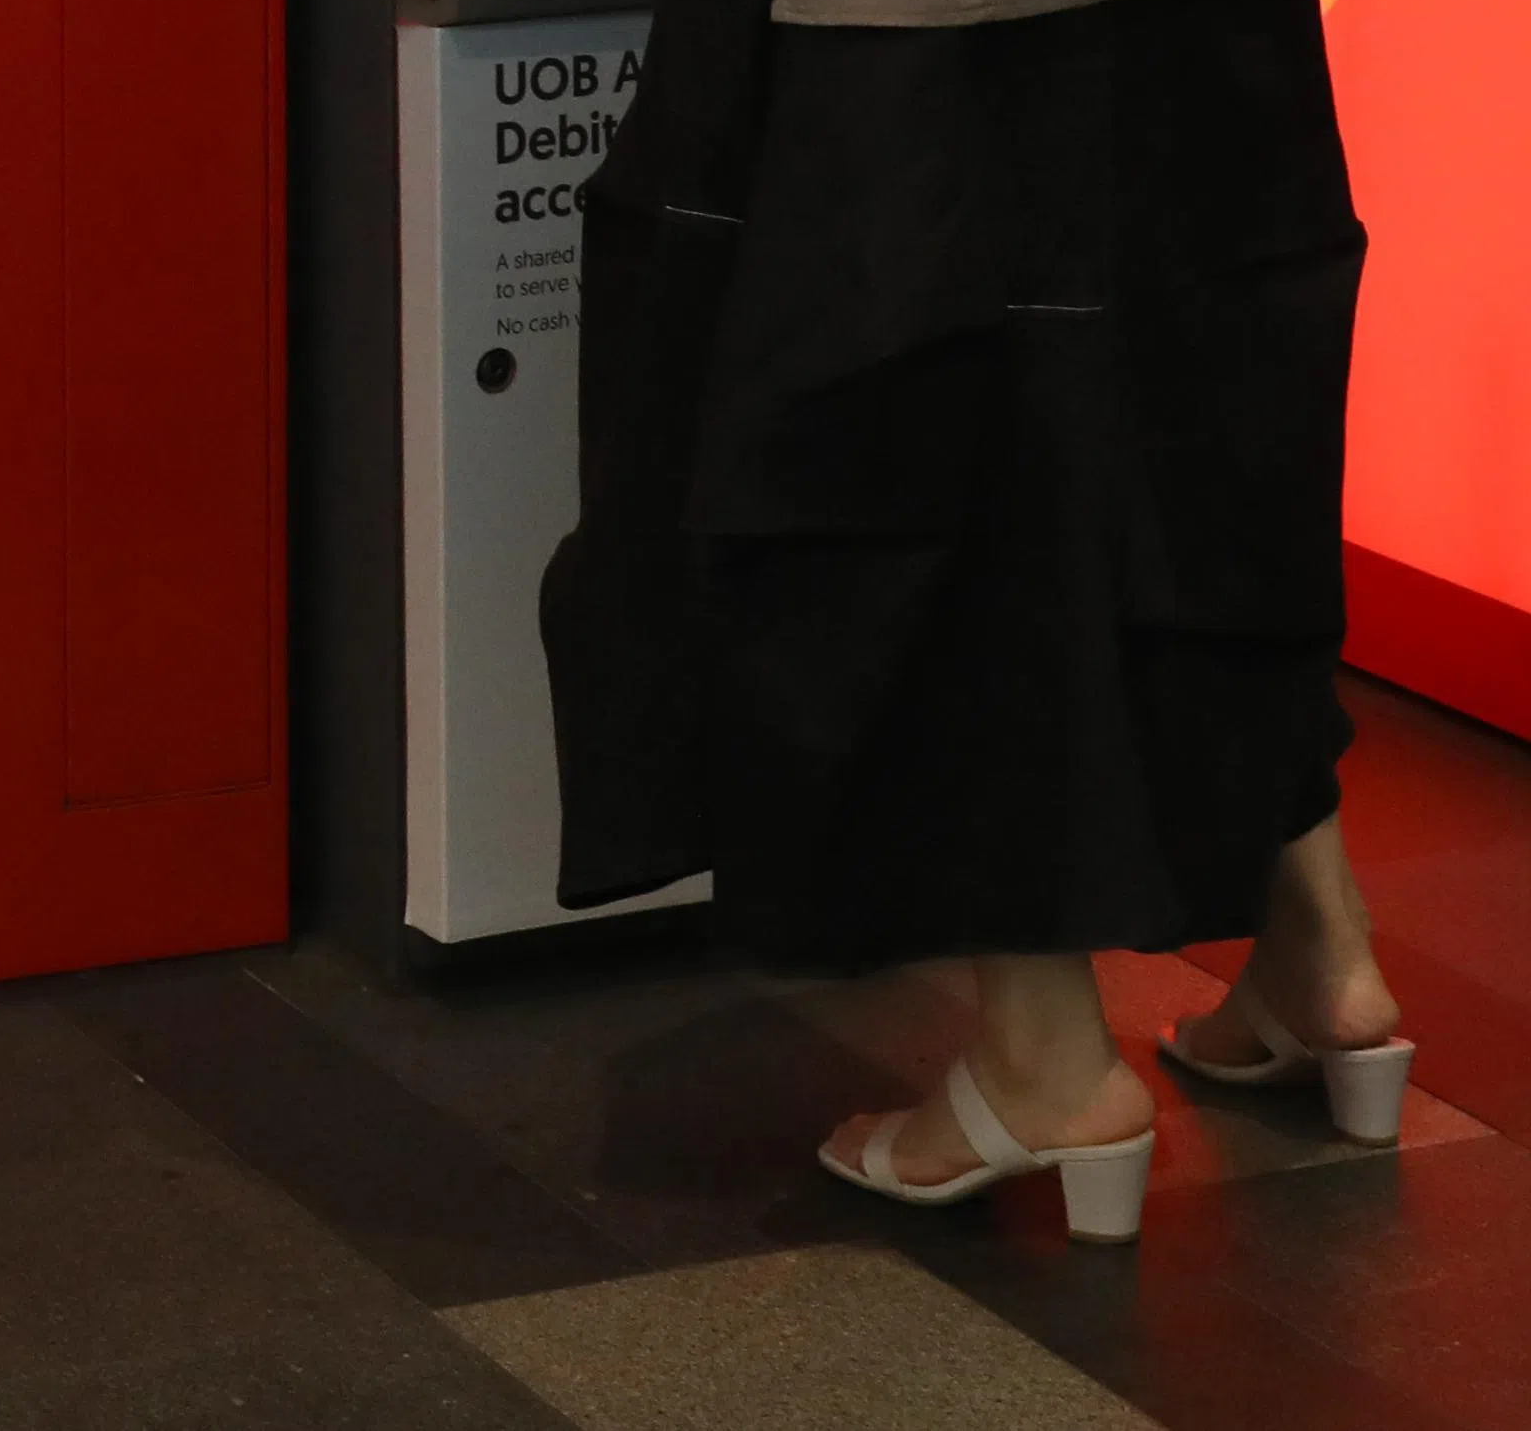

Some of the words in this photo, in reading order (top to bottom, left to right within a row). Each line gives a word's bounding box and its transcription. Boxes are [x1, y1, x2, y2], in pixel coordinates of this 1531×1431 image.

[494, 54, 599, 105] UOB
[495, 110, 618, 165] Debit
[496, 252, 509, 271] A
[514, 245, 575, 268] shared
[496, 282, 516, 299] to
[520, 278, 570, 296] serve
[496, 317, 524, 336] No
[528, 311, 570, 332] cash
